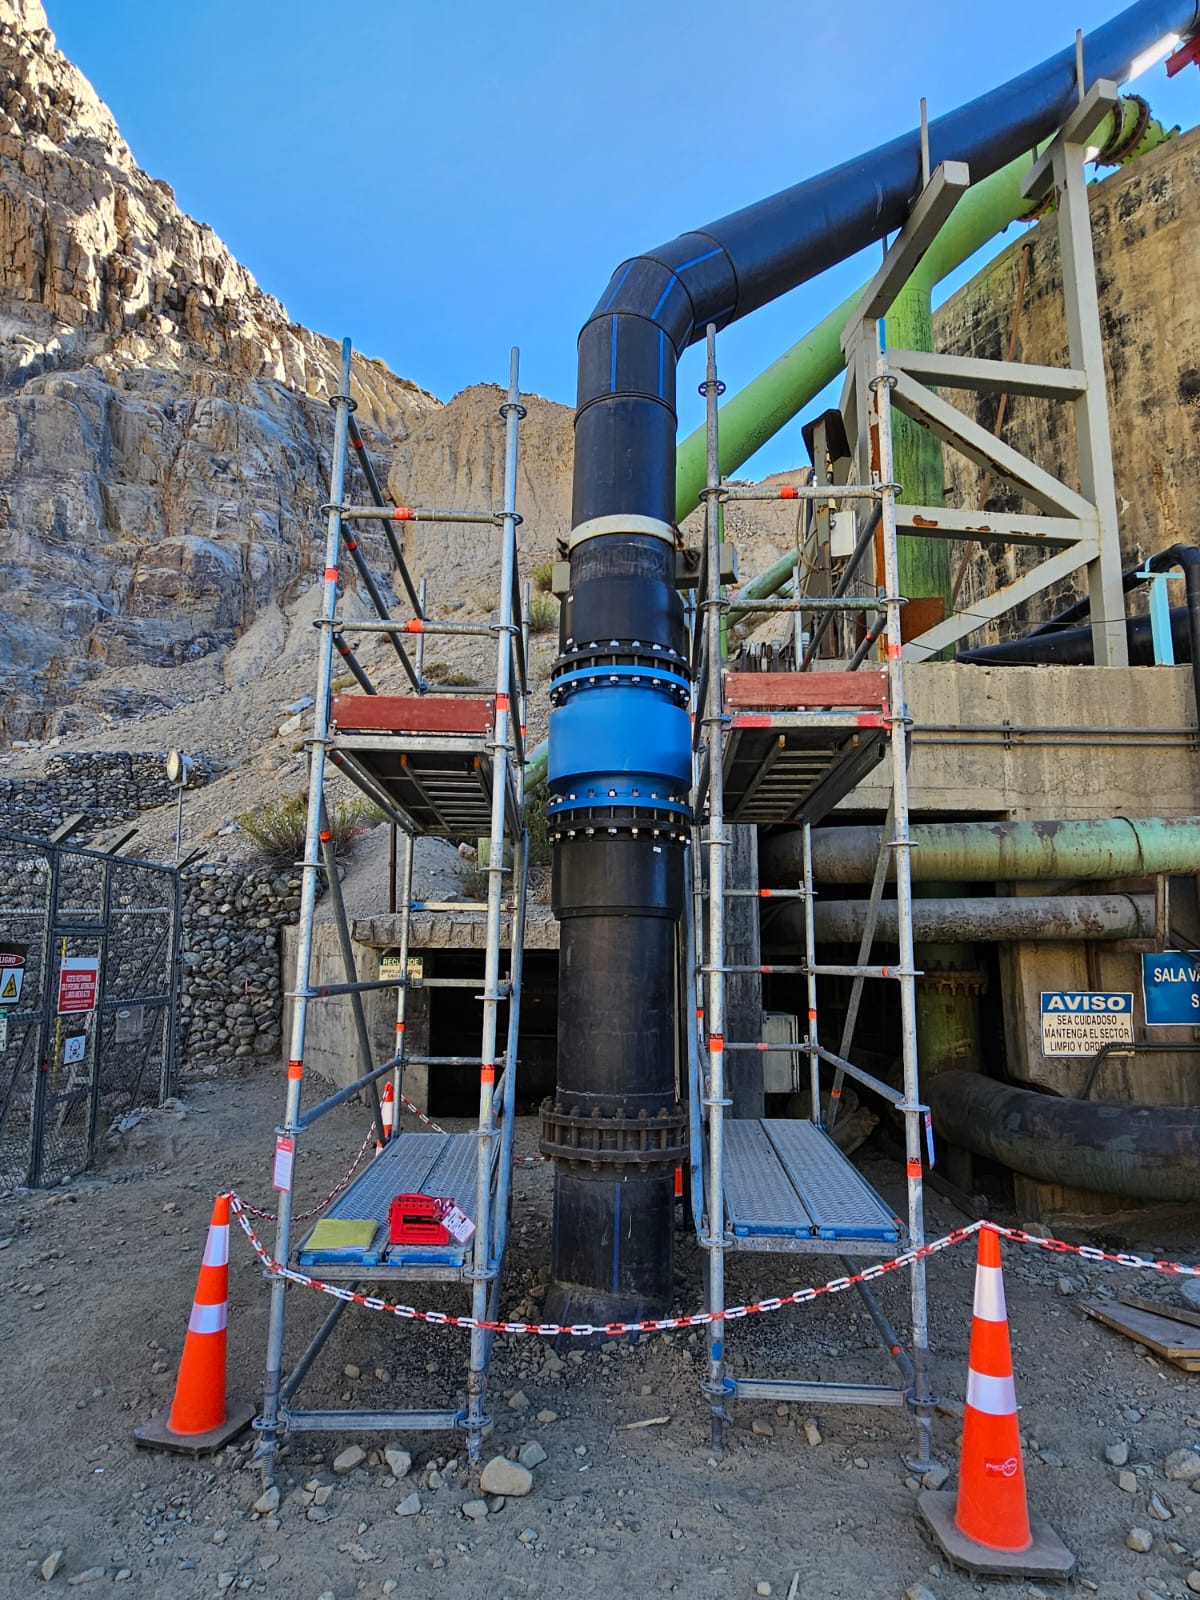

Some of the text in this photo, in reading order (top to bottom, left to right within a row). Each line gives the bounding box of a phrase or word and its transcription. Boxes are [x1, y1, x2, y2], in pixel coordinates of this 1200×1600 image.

[1154, 968, 1187, 982] SALA
[1047, 996, 1126, 1010] AVISO
[1057, 1015, 1117, 1025] SEA CUIDADOSO
[1044, 1028, 1129, 1038] MANTENGA EL SECTOR
[1050, 1041, 1075, 1051] LIMPIO
[1077, 1042, 1083, 1051] Y
